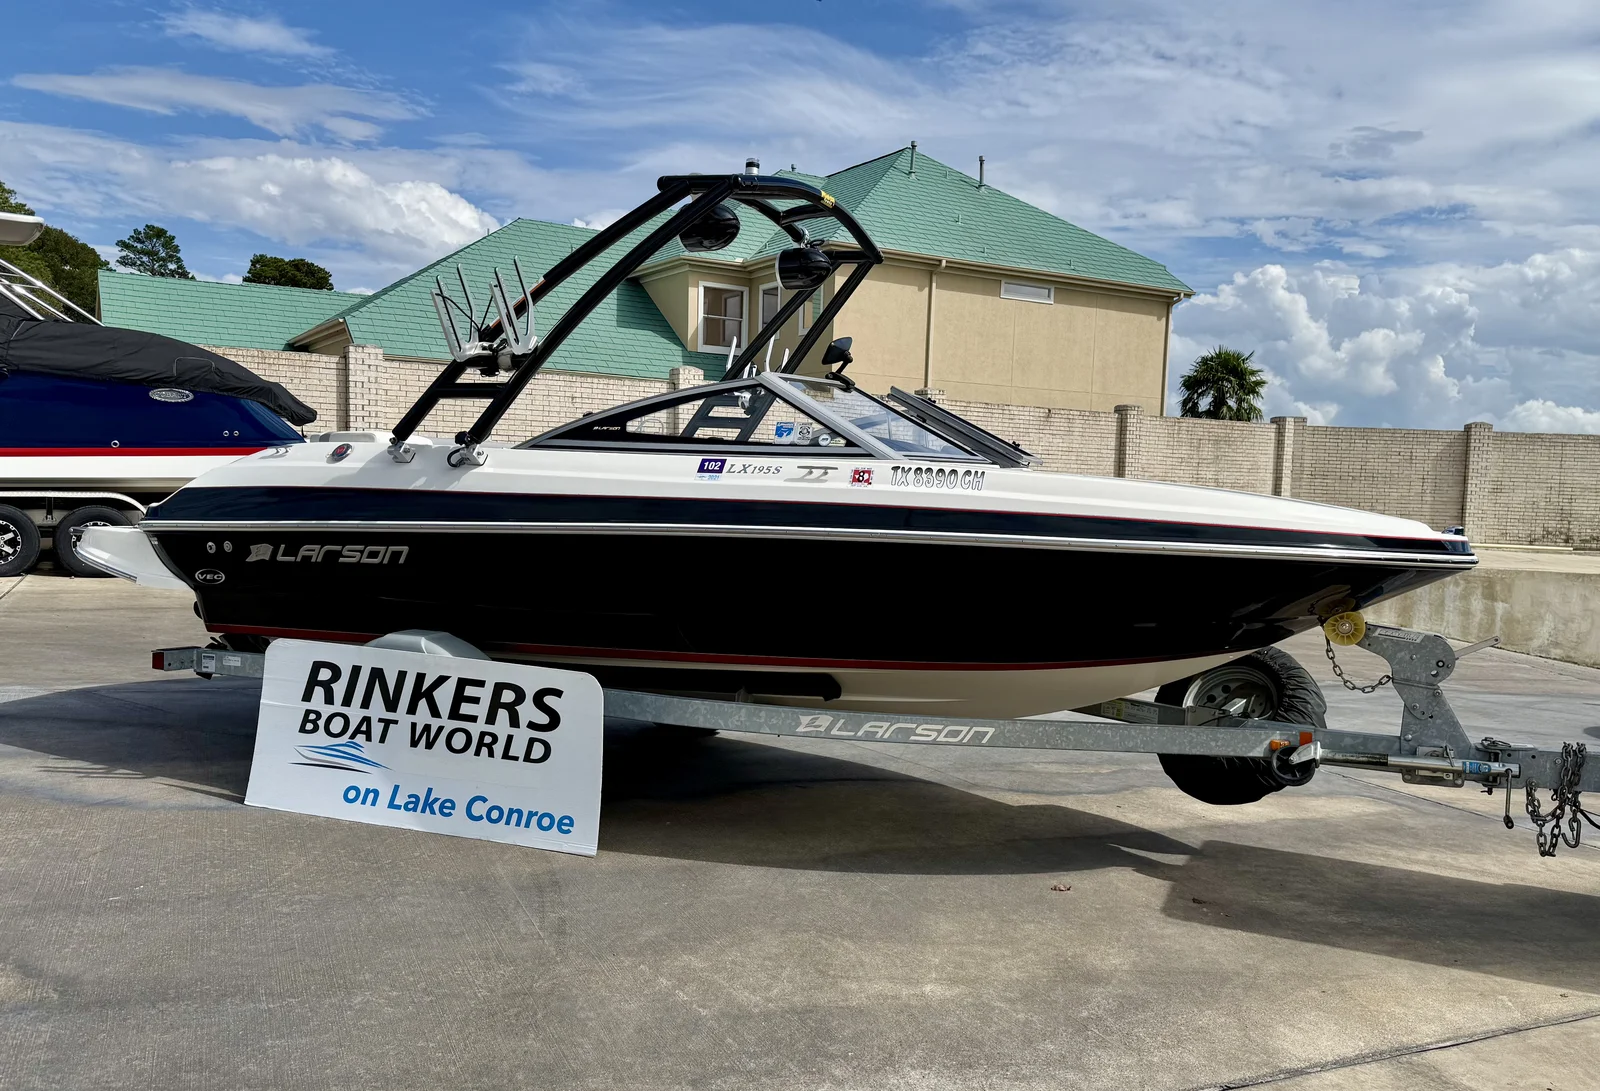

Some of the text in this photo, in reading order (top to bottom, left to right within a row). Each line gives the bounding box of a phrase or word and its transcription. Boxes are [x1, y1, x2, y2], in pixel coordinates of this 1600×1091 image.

[703, 461, 721, 470] 102
[302, 661, 564, 733] RINKERS
[298, 709, 552, 764] BOAT WORLD
[343, 784, 575, 835] on Lake Conroe
